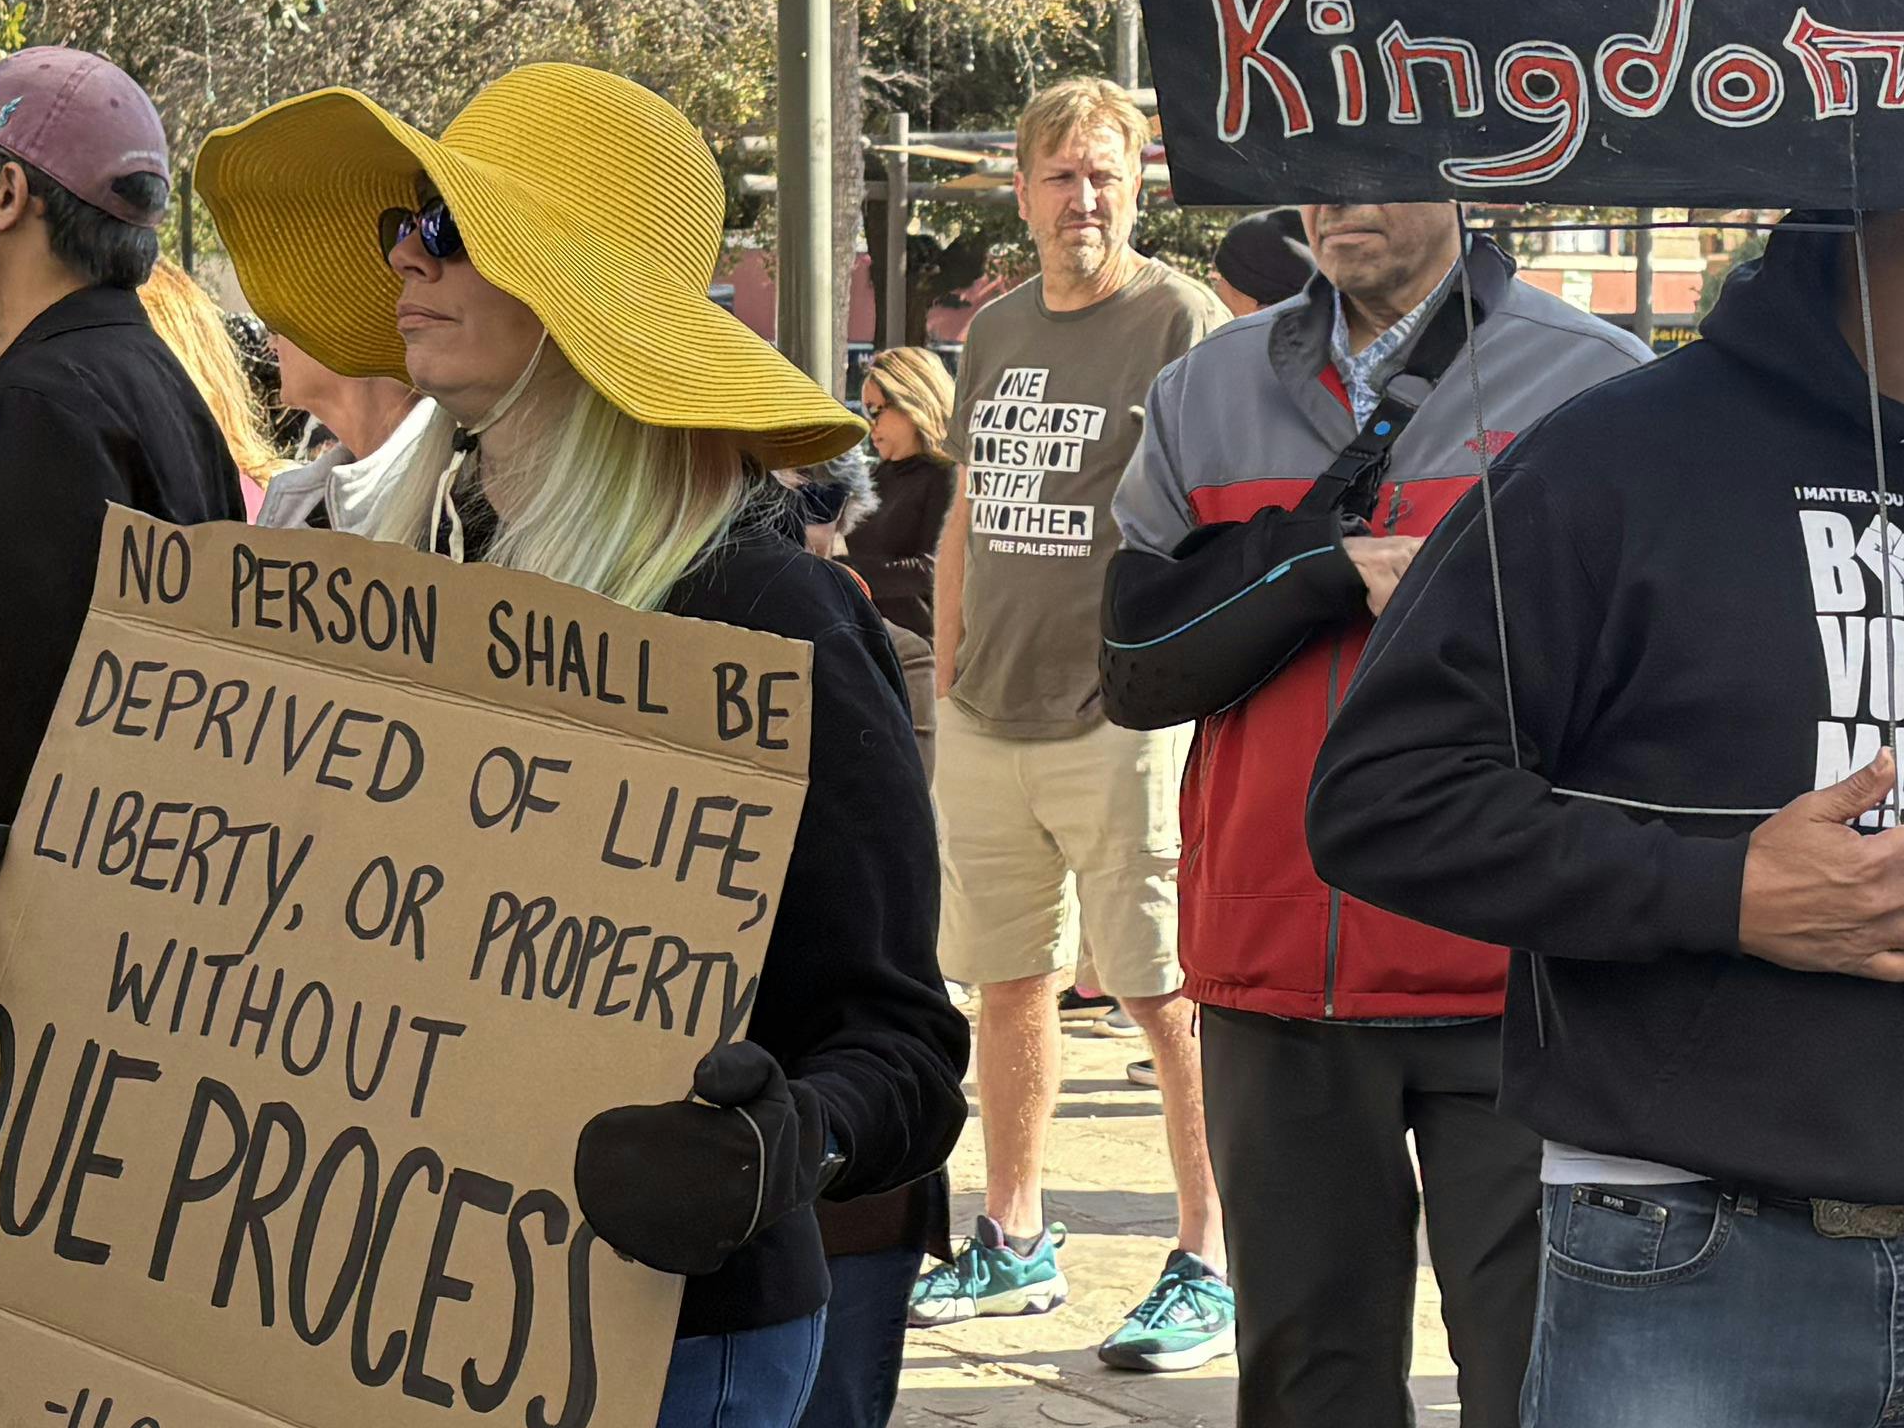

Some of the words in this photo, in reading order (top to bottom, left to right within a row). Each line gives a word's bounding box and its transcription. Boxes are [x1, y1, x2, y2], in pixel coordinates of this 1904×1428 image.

[1000, 372, 1042, 397] ONE
[973, 404, 1099, 435] HOLOCAUST
[974, 437, 1028, 466] DOES
[1033, 441, 1079, 467] NOT
[975, 503, 1087, 535] ANOTHER
[989, 540, 1014, 553] FREE
[1017, 542, 1091, 557] PALESTINE!
[117, 525, 192, 608] NO
[231, 545, 438, 663] PERSON
[488, 599, 669, 716] SHALL
[713, 665, 799, 749] BE
[74, 650, 426, 804] DEPRIVED
[469, 744, 573, 835] OF
[601, 780, 774, 931] LIFE,
[32, 772, 314, 953] LIBERTY,
[344, 856, 442, 960] OR
[470, 890, 757, 1047] PROPERTY
[106, 931, 466, 1119] WITHOUT
